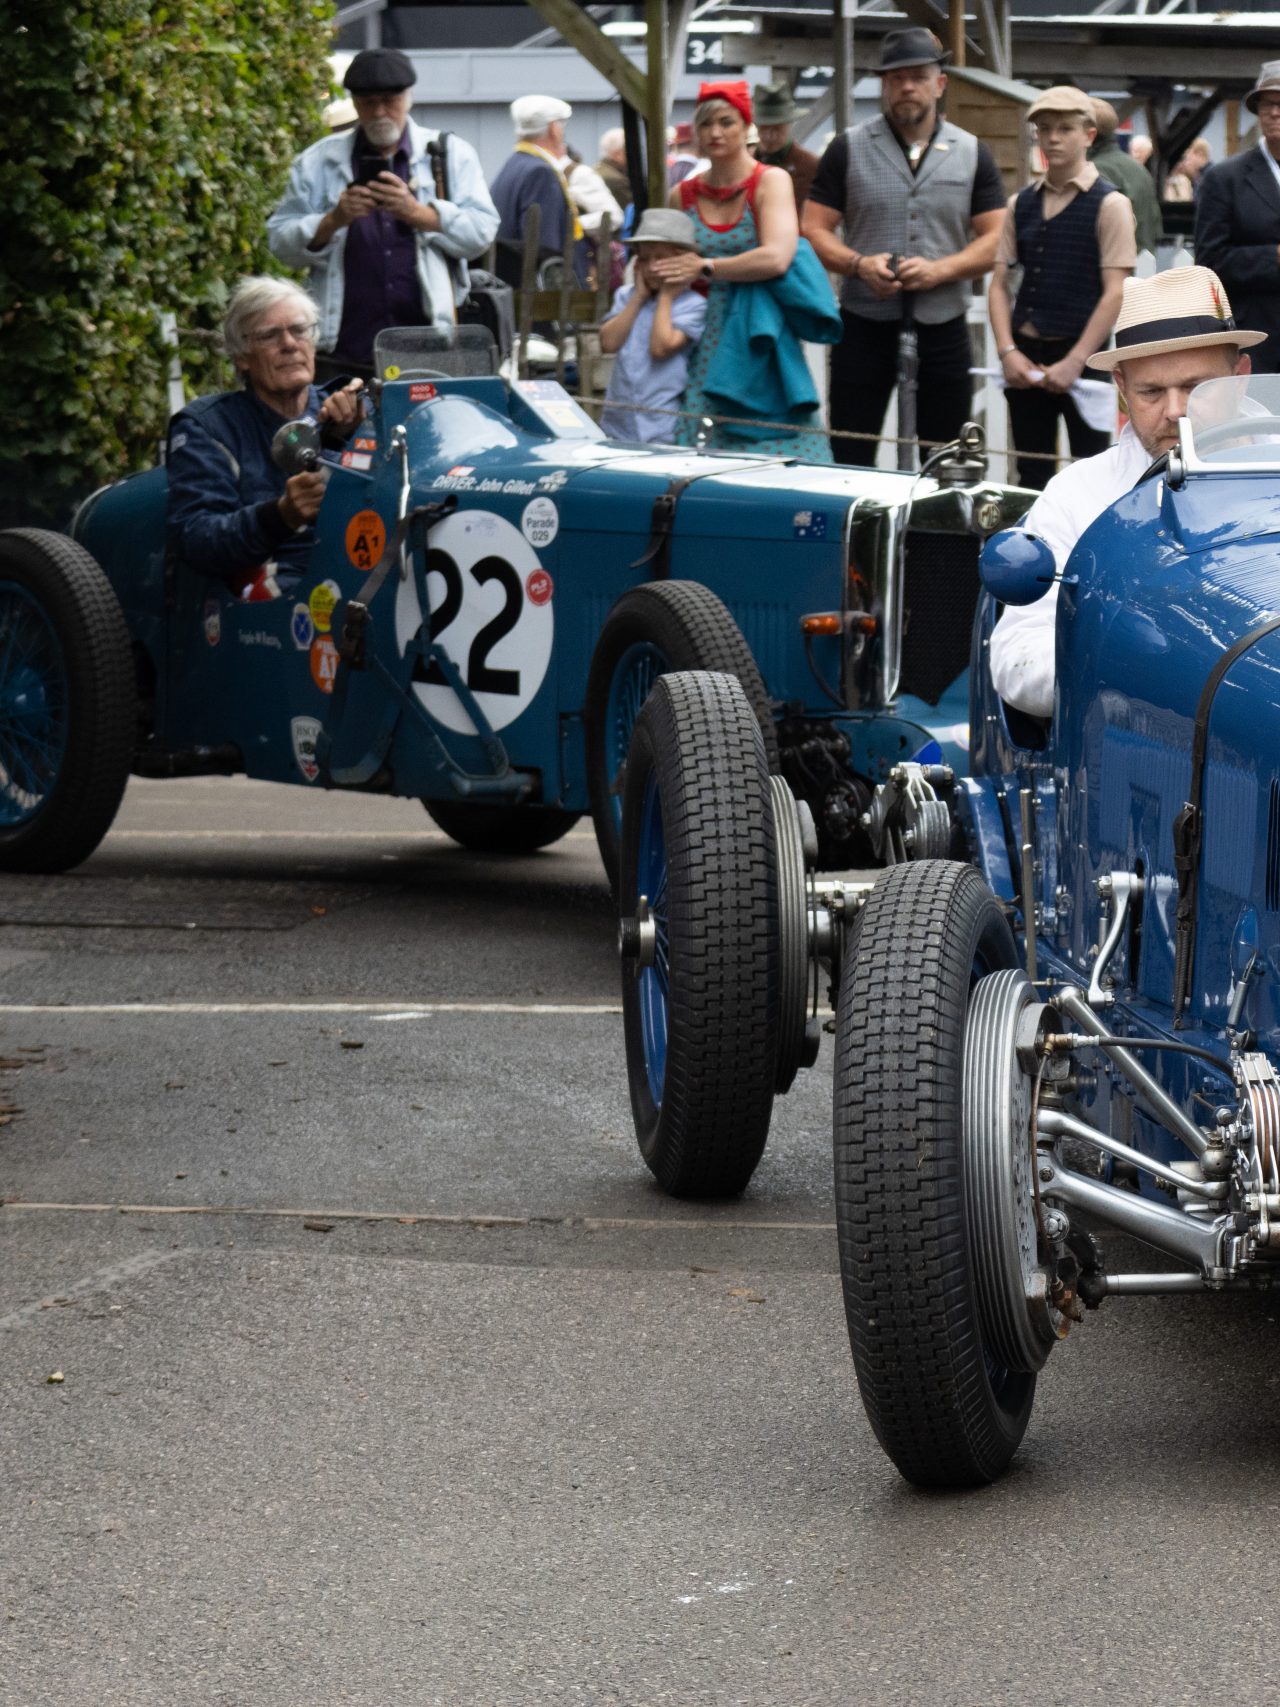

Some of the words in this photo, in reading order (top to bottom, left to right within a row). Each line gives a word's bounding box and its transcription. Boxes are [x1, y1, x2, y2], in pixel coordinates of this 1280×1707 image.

[688, 39, 722, 65] 34
[432, 475, 477, 491] DRIVER:
[475, 478, 503, 493] John
[503, 479, 536, 495] Gillett
[526, 517, 555, 528] Parade
[532, 530, 549, 541] 029
[412, 547, 524, 696] 22
